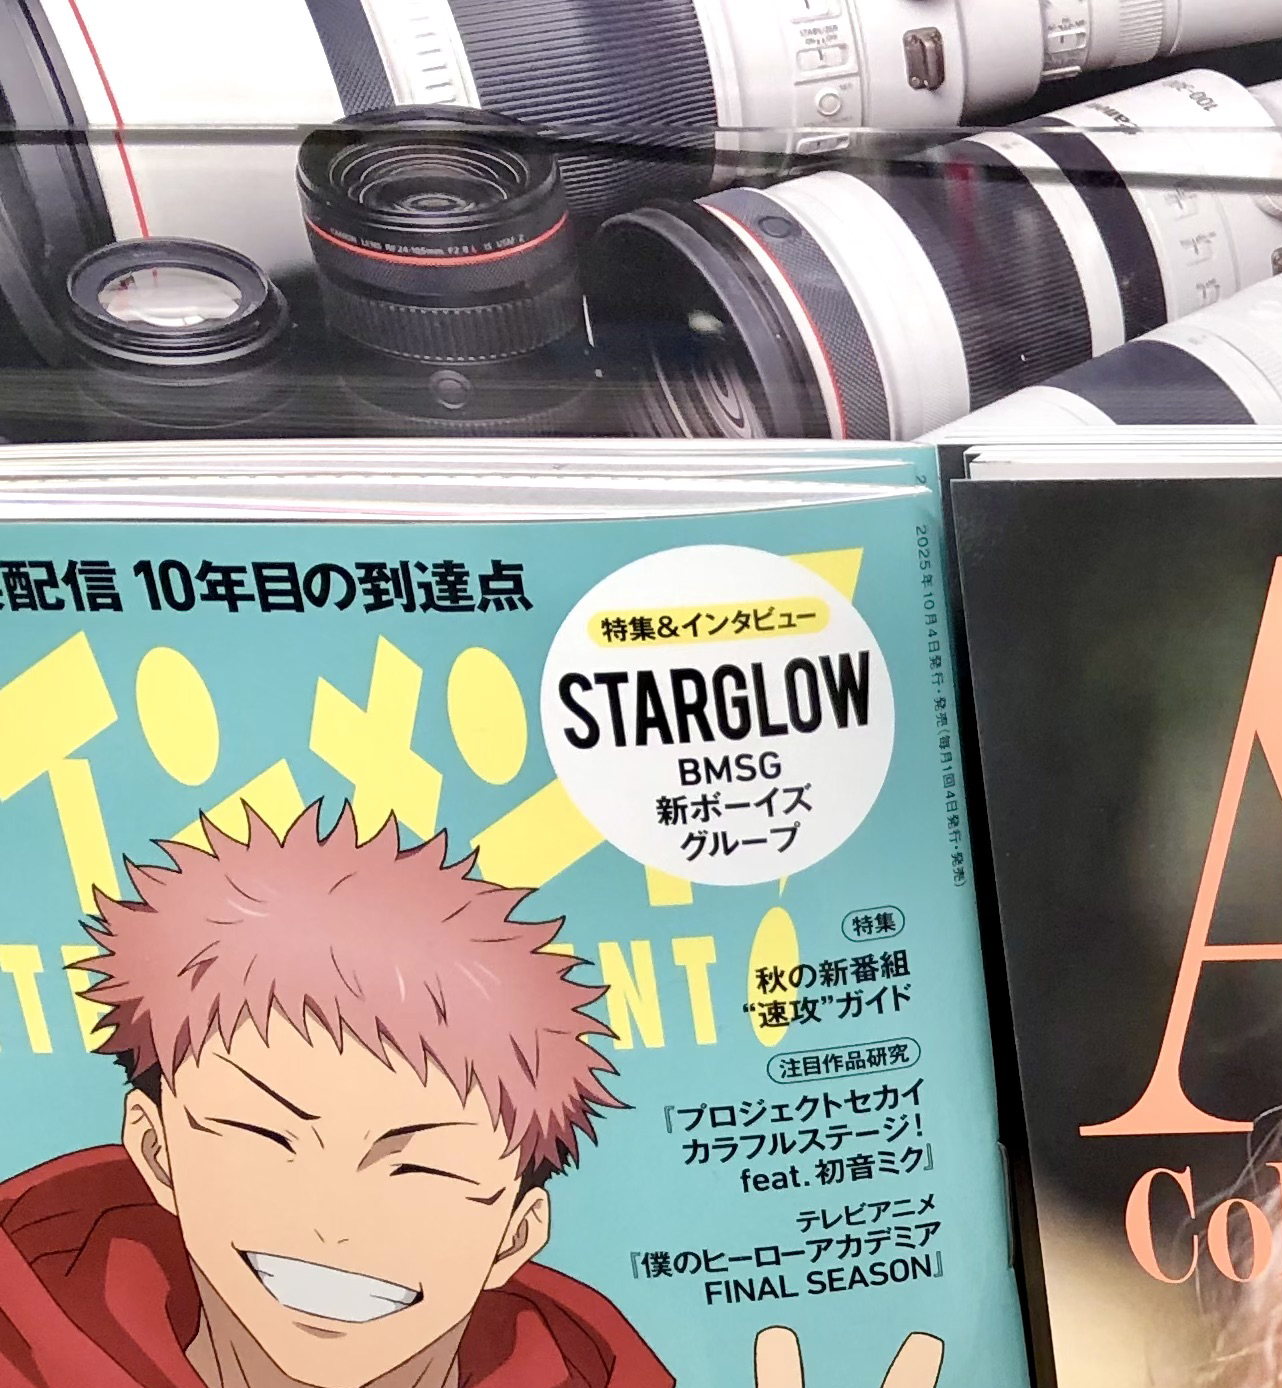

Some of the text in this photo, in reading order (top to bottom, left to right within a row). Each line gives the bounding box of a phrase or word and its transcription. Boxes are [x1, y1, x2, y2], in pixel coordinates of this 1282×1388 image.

[0, 559, 534, 613] 配信 10年目の到達点
[557, 650, 870, 750] STARGLOW
[677, 752, 782, 786] BMSG
[656, 783, 814, 826] 新ボーイズ
[679, 821, 802, 862] グループ
[851, 911, 896, 936] 特集
[755, 949, 911, 994] 秋の新番組
[779, 1044, 910, 1079] 注目作品研究
[663, 1078, 925, 1134] 『プロジェクトセカイ
[796, 1193, 937, 1234] テレビアニメ
[629, 1220, 941, 1280] 『僕のヒーローアカデミア
[704, 1274, 799, 1306] FINAL
